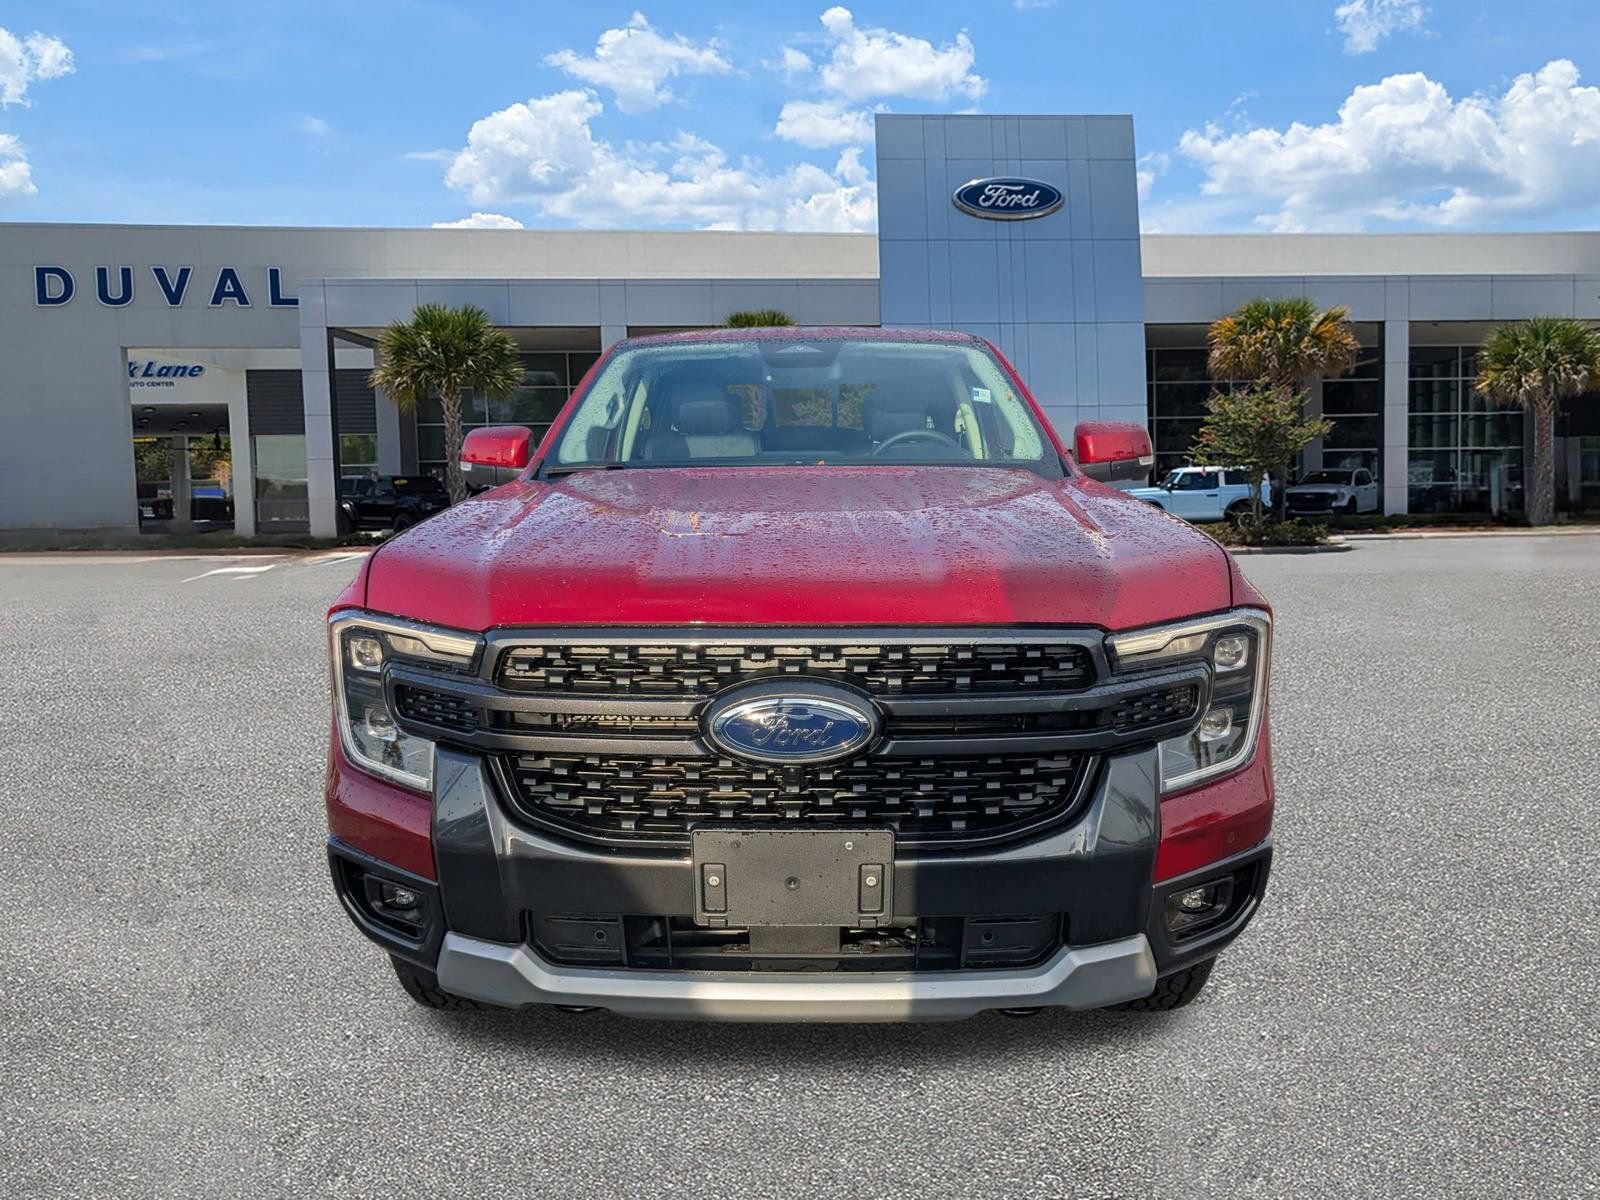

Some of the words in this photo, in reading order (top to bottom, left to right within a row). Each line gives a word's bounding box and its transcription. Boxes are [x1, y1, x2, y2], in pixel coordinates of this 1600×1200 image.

[979, 184, 1040, 207] Ford
[35, 266, 299, 307] DUVAL
[141, 361, 204, 378] Lane
[751, 711, 835, 746] Ford
